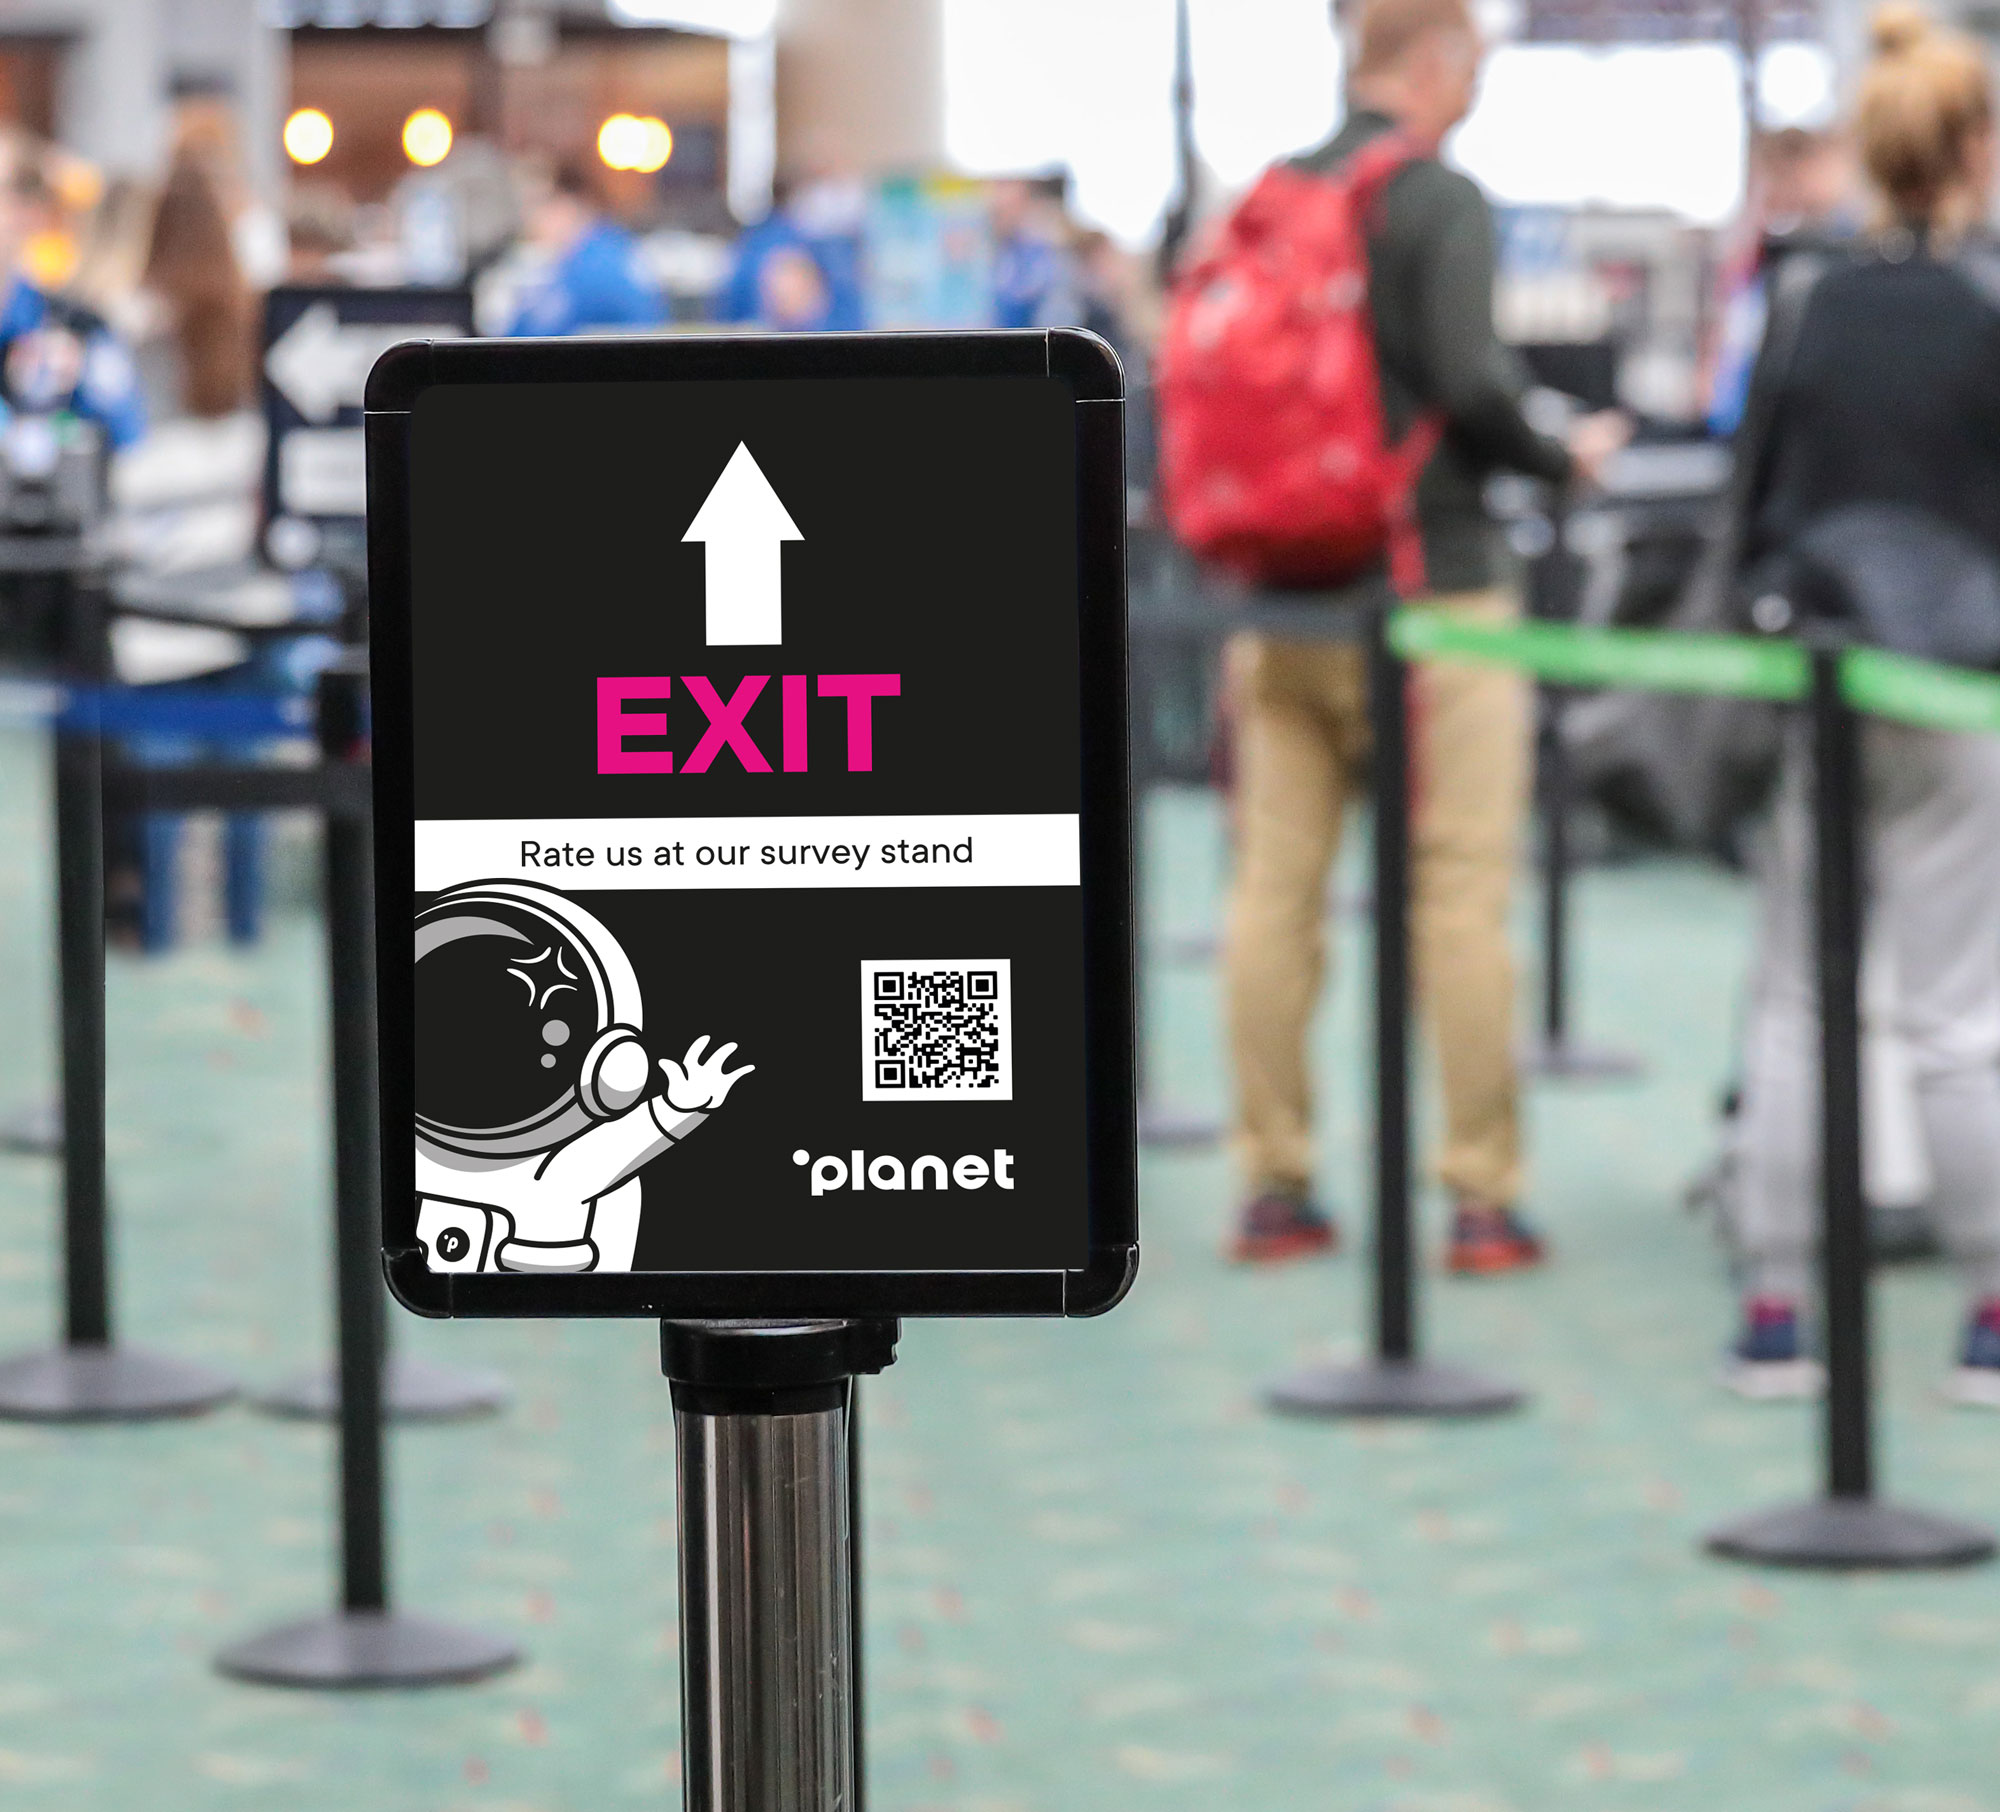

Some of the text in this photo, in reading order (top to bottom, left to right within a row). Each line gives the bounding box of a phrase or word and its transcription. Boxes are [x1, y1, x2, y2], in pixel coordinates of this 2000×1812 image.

[596, 673, 902, 775] EXIT
[520, 836, 973, 871] Rate us at our survey stand
[793, 1148, 1015, 1197] planet
